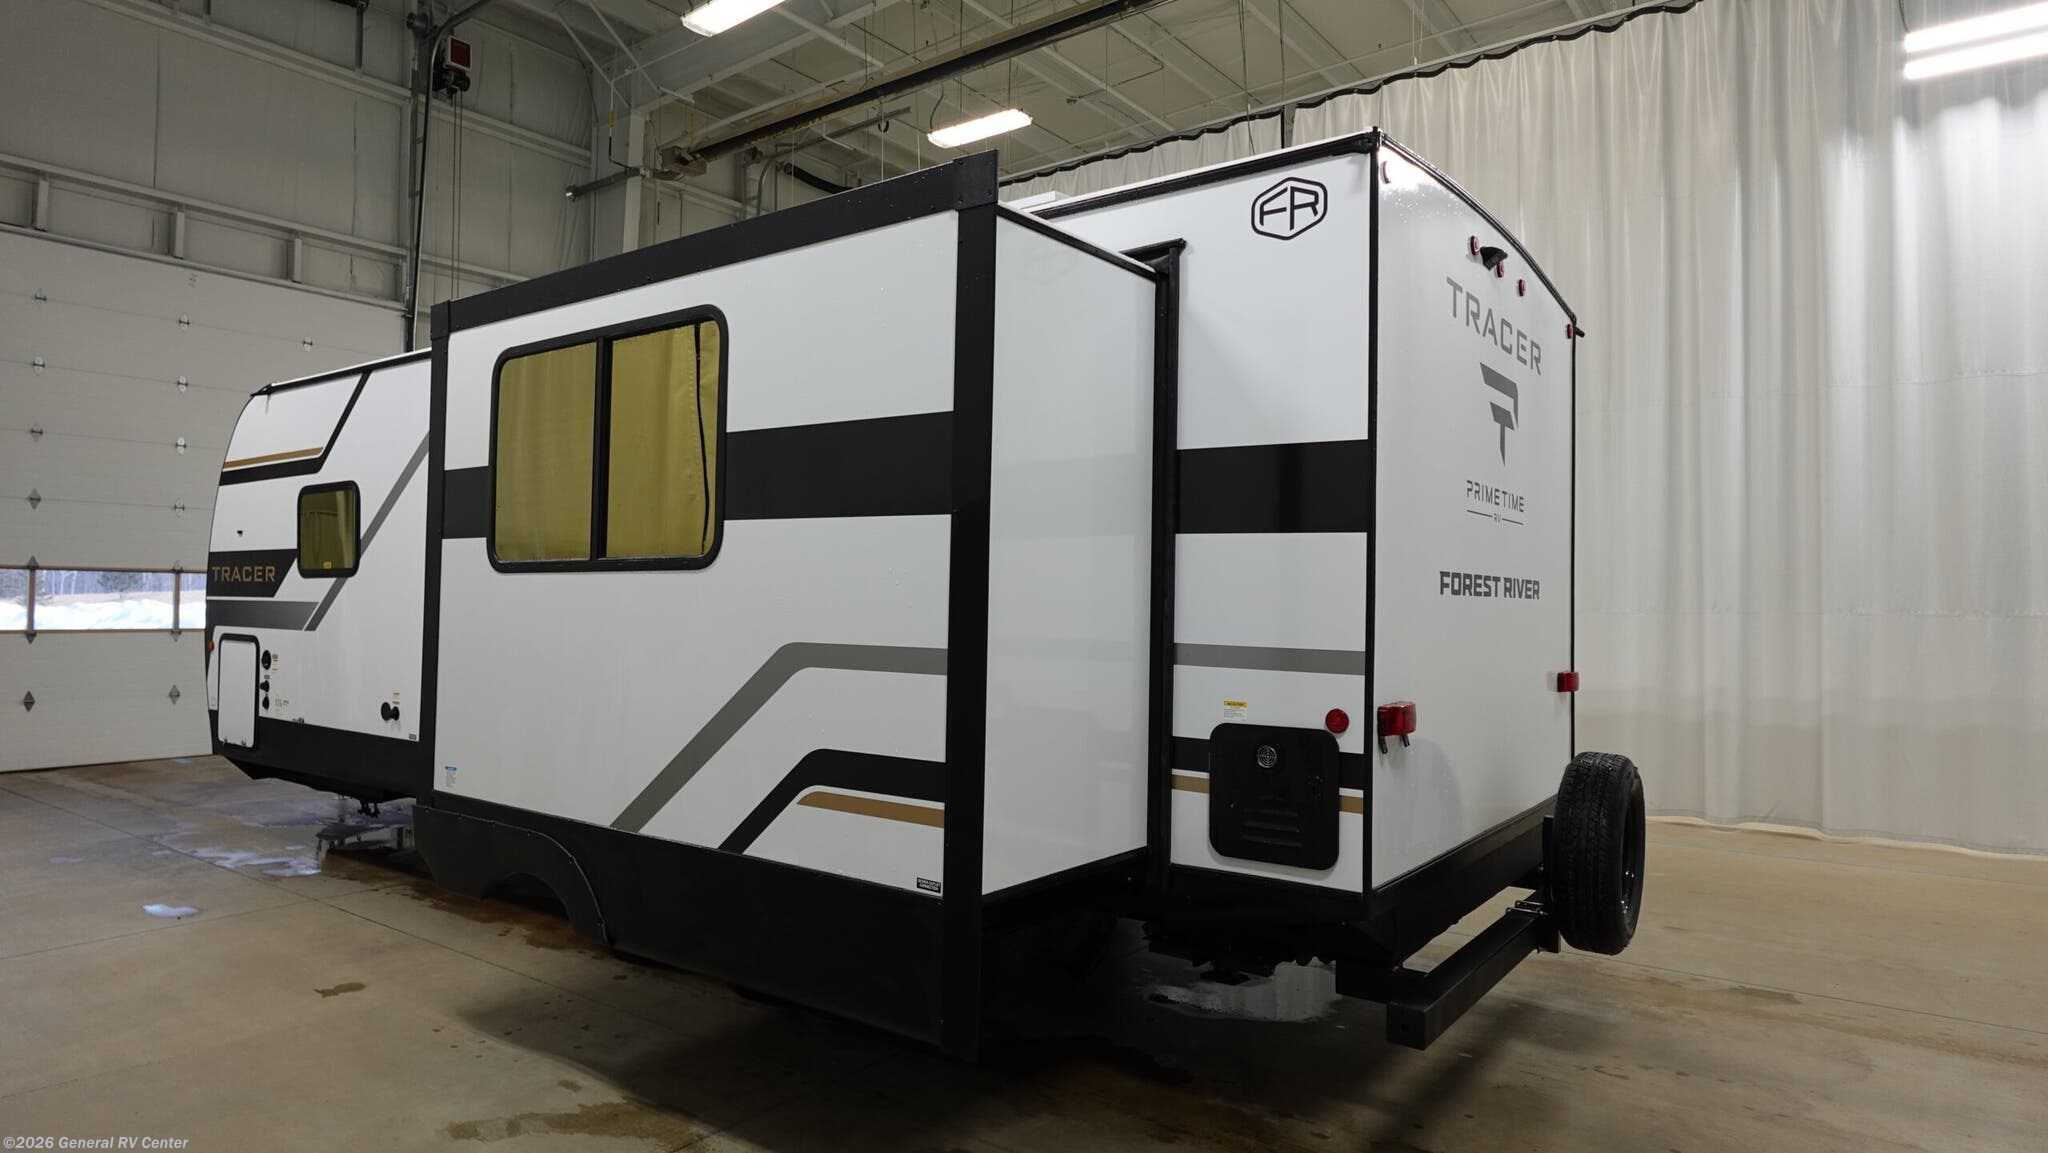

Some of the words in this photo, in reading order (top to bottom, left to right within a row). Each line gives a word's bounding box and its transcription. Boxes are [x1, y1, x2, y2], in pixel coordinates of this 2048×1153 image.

[1259, 186, 1320, 231] FR
[1446, 276, 1543, 376] TRACER
[1493, 513, 1502, 523] RV
[212, 566, 276, 583] TRACER
[1439, 571, 1501, 598] FOREST
[1503, 577, 1541, 600] RIVER
